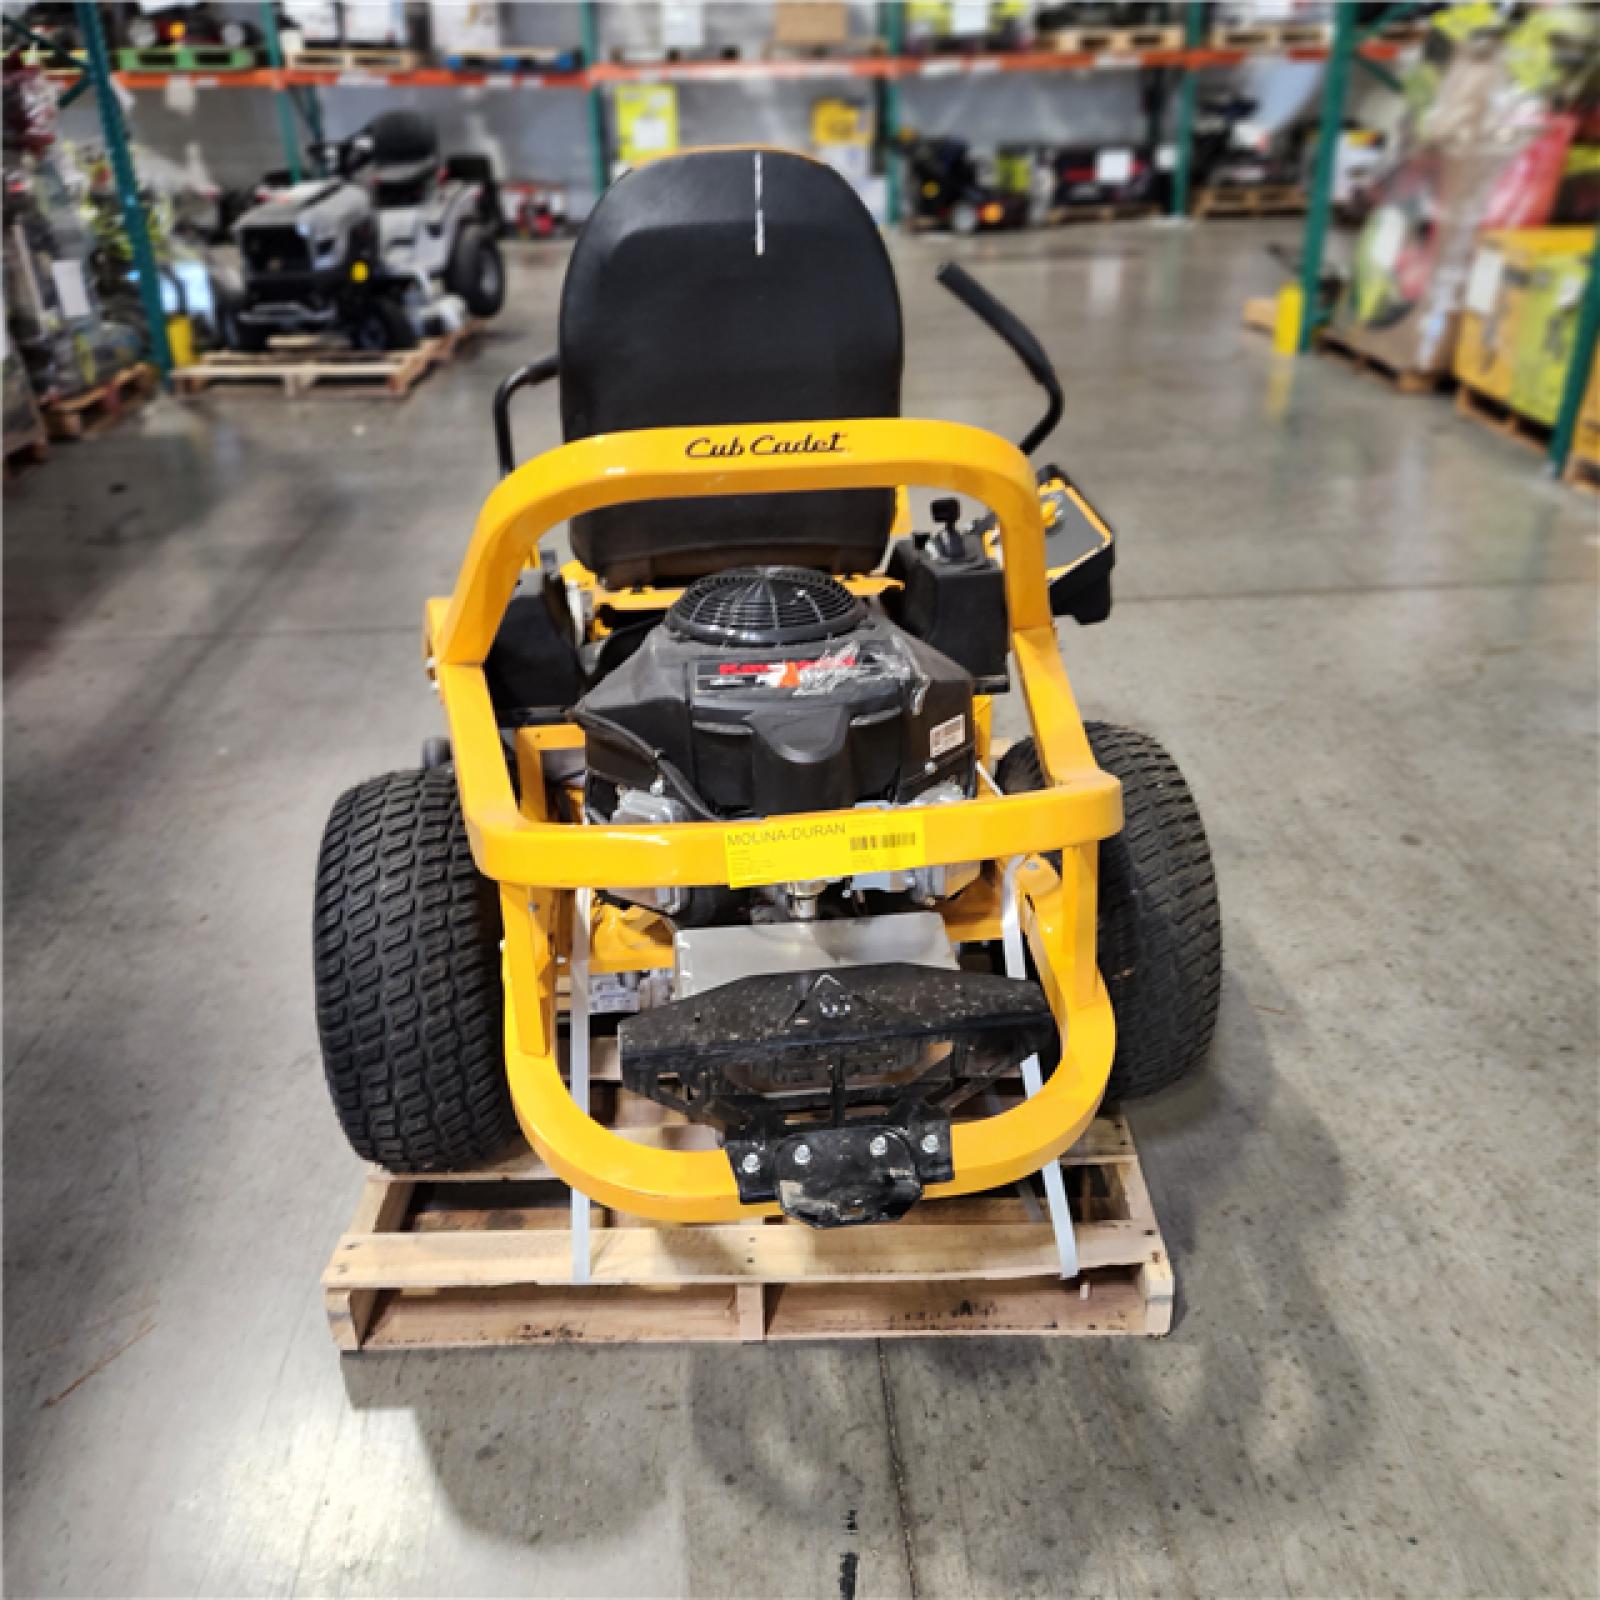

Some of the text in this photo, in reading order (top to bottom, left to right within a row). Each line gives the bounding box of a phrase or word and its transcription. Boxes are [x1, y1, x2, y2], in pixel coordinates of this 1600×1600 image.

[685, 432, 848, 459] Cub Cadet
[727, 822, 846, 847] MOLINA-DURAN
